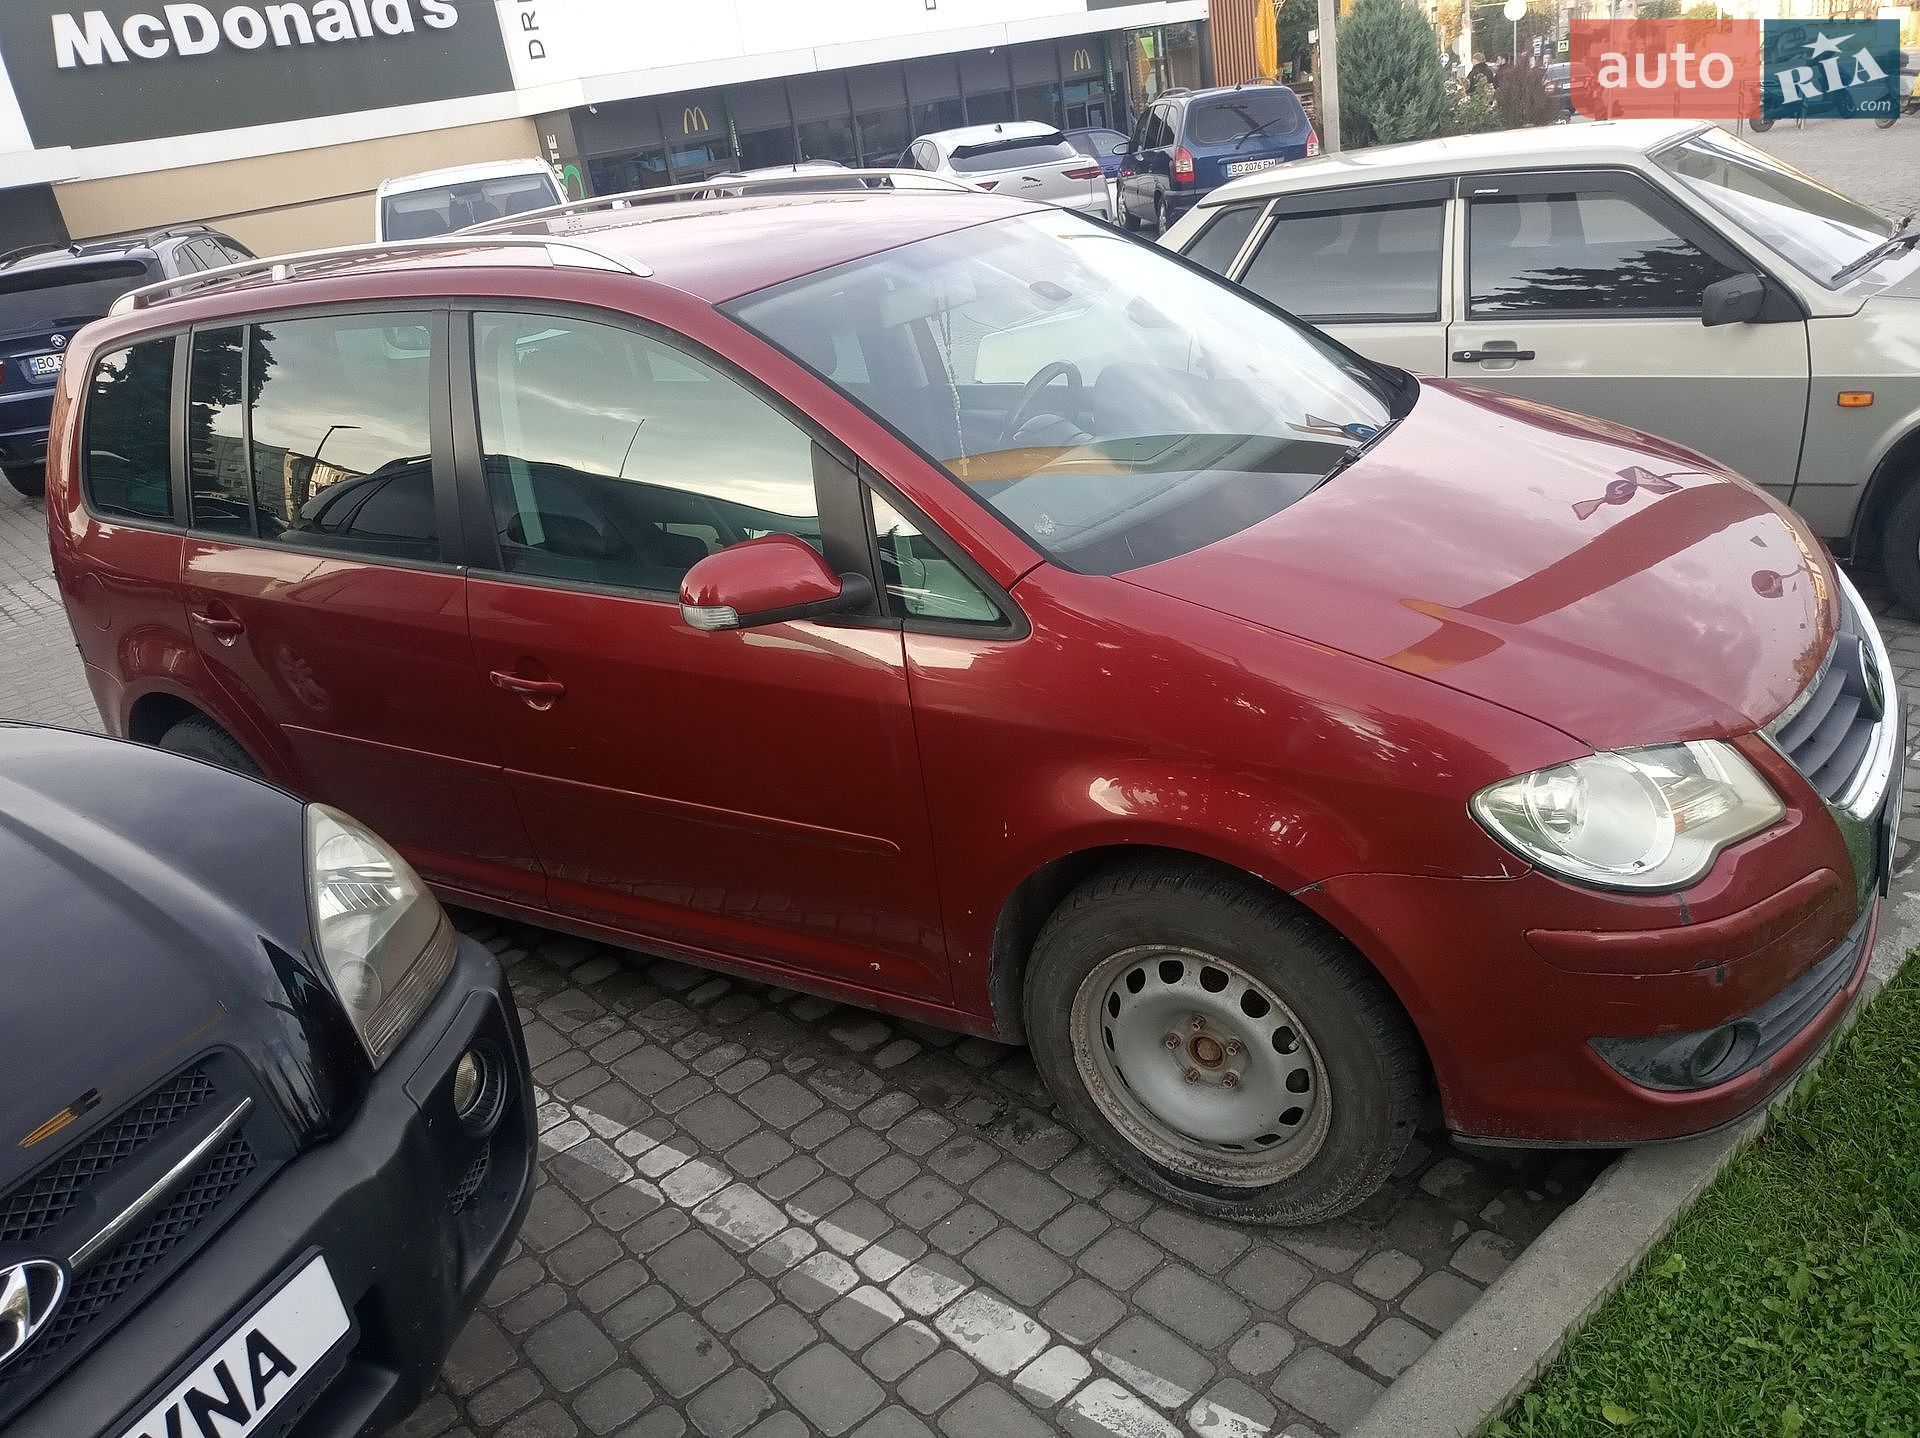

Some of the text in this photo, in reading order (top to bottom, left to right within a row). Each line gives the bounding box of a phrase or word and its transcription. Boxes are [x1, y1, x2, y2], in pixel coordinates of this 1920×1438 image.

[52, 0, 459, 69] McDonalds
[1244, 161, 1262, 171] 2076
[36, 357, 55, 370] BO
